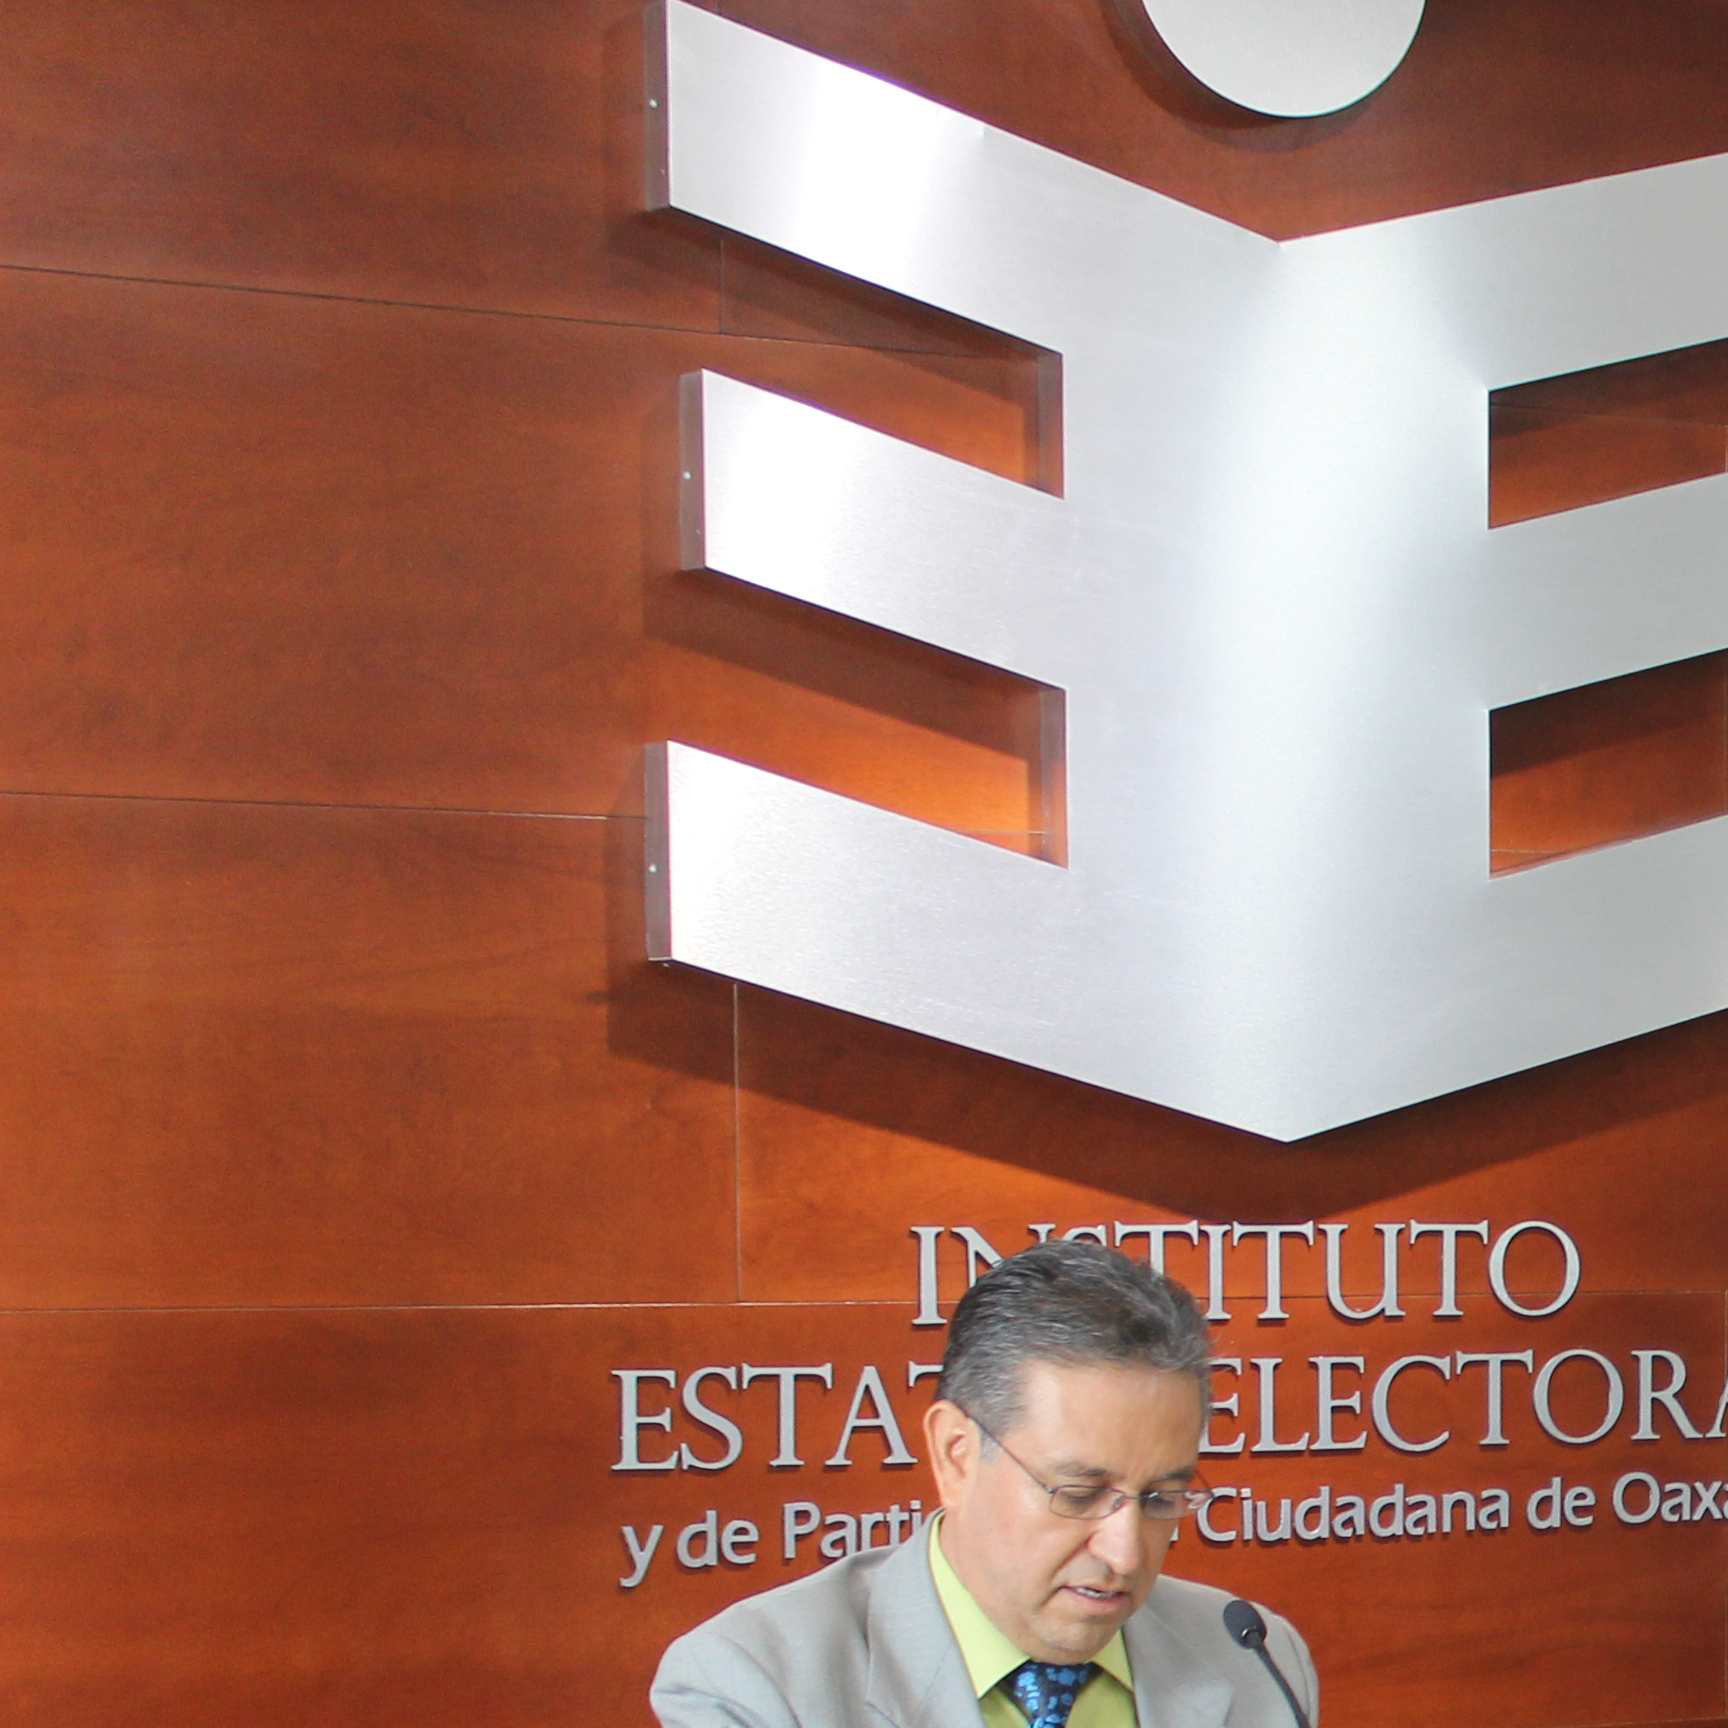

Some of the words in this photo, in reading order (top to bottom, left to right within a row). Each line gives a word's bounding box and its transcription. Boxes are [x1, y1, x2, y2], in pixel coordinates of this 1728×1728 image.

[911, 1219, 1581, 1325] ITITUTO
[611, 1362, 945, 1471] ESTA
[619, 1523, 664, 1588] y
[676, 1509, 760, 1568] de
[1197, 1483, 1510, 1542] Ciudadana
[1526, 1476, 1596, 1531] de
